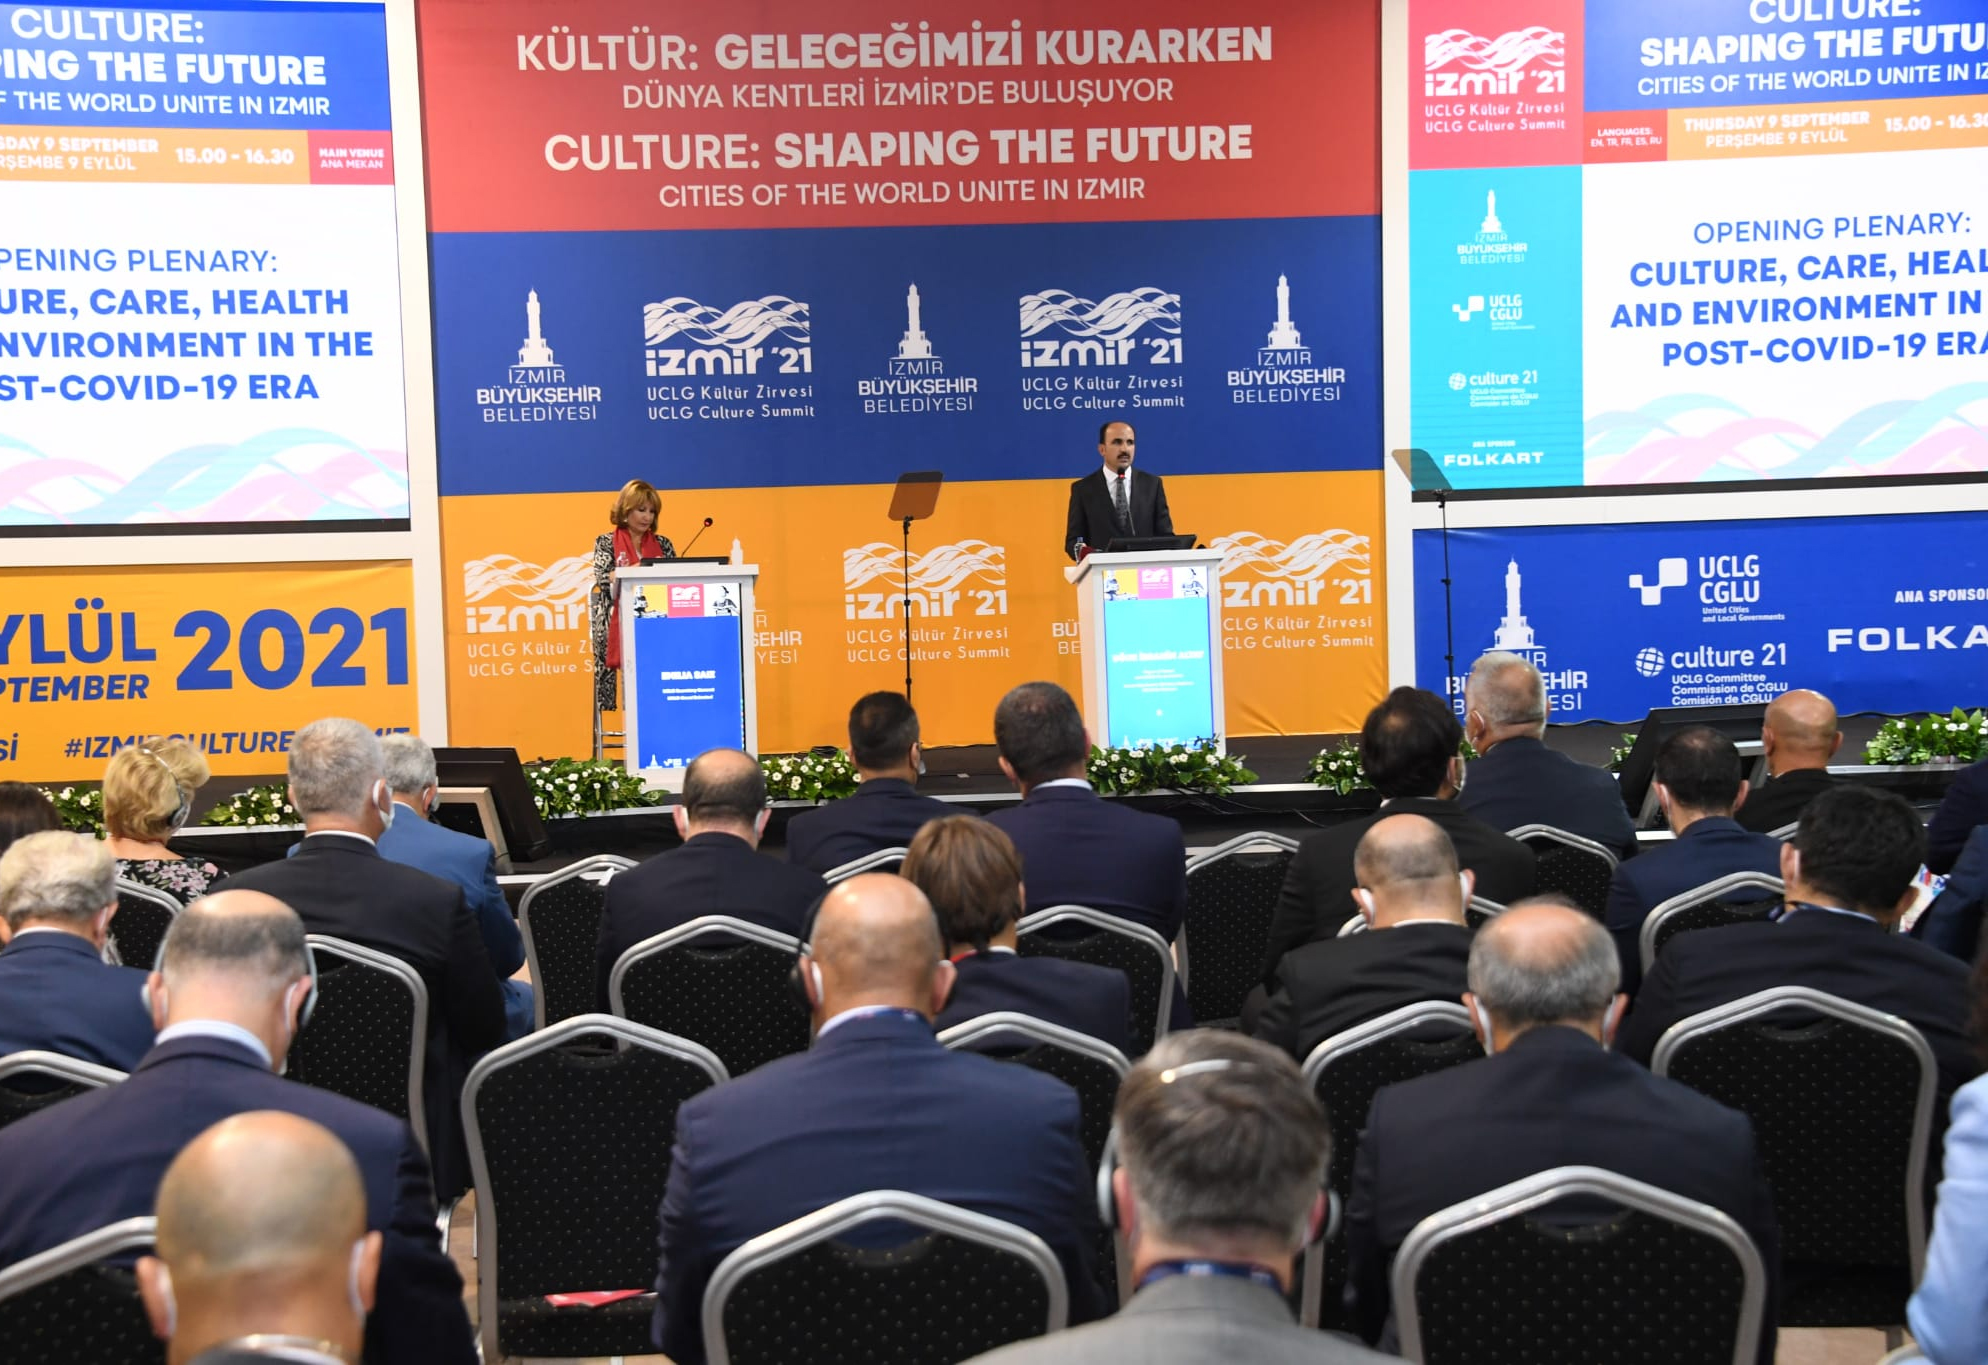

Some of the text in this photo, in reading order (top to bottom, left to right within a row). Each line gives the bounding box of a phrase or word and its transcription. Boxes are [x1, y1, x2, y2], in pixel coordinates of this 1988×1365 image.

[11, 8, 204, 43] CULTURE:
[517, 20, 1272, 71] KÜLTÜR: GELECEĞİMİZİ KURARKEN
[1641, 23, 1988, 66] SHAPING THE FUTU
[88, 51, 326, 85] THE FUTURE
[1638, 64, 1969, 95] CITIES OF THE WORLD UNITE IN
[623, 79, 723, 108] DÜNYA
[733, 78, 864, 107] KENTLERİ
[1003, 78, 1173, 107] BULUŞUYOR
[13, 91, 61, 110] THE
[67, 93, 156, 112] WORLD
[163, 95, 232, 113] UNITE
[239, 96, 262, 114] IN
[269, 97, 330, 115] IZMIR
[1425, 102, 1564, 117] UCLG Kültür Zirvesi
[1426, 118, 1565, 133] UCLG Culture Summit
[1684, 111, 1870, 132] THURSDAY 9 SEPTEMBER
[1885, 115, 1932, 132] 15.00
[1598, 128, 1652, 137] LANGUAGES:
[1706, 127, 1848, 148] PERŞEMBE 9 EYLÜL
[44, 137, 158, 152] 9 SEPTEMBER
[545, 125, 1252, 171] CULTURE: SHAPING THE FUTURE
[68, 154, 136, 170] 9 EYLÜL
[176, 148, 294, 165] 15.00 16.30
[349, 149, 384, 158] VENUE
[320, 159, 383, 169] ANA MEKAN
[660, 178, 1144, 207] CITIES OF THE WORLD UNITE IN IZMIR
[1694, 212, 1970, 244] OPENING PLENARY:
[128, 250, 276, 272] PLENARY:
[1630, 258, 1787, 287] CULTURE,
[1798, 253, 1896, 281] CARE,
[90, 289, 348, 320] CARE, HEALTH
[1490, 294, 1522, 307] UCLG
[1611, 290, 1981, 328] AND ENVIRONMENT IN
[1490, 307, 1522, 321] CGLU
[258, 332, 294, 356] IN
[305, 332, 373, 356] THE
[1021, 337, 1134, 367] izmir
[1664, 333, 1926, 366] POST-COVID-19
[646, 346, 765, 377] izmir
[1023, 375, 1182, 391] UCLG Kültür Zirvesi
[1228, 367, 1345, 386] BÜYÜKŞEHİR
[1470, 370, 1537, 385] culture 21
[249, 375, 319, 399] ERA
[648, 385, 812, 401] UCLG Kültür Zirvesi
[858, 376, 977, 395] BÜYÜKŞEHİR
[477, 385, 601, 404] BÜYÜKŞEHİR
[1023, 395, 1184, 410] UCLG Culture Summit
[1233, 386, 1340, 403] BELEDİYESİ
[649, 404, 814, 420] UCLG Culture Summit
[865, 396, 972, 413] BELEDİYESİ
[484, 405, 596, 422] BELEDİYESİ
[1444, 452, 1544, 466] FOLKART
[1699, 555, 1759, 578] UCLG
[1700, 580, 1759, 604] CGLU
[1895, 588, 1988, 603] ANA SPONSO
[466, 603, 586, 634] izmir
[1223, 615, 1372, 631] CLG Kültür Zirvesi
[1718, 614, 1737, 622] Local
[847, 627, 1007, 644] UCLG Kültür Zirvesi
[1223, 634, 1374, 649] CLG Culture Summit
[174, 608, 408, 690] 2021
[468, 643, 516, 658] UCLG
[522, 641, 570, 655] Kültür
[848, 646, 1009, 662] UCLG Culture Summit
[1671, 643, 1785, 668] culture 21
[469, 662, 514, 677] UCLG
[520, 661, 577, 675] Culture
[1672, 673, 1766, 684] UCLG Committee
[1672, 682, 1788, 695] Commission de CGLU
[1672, 693, 1773, 705] Comisión de CGLU
